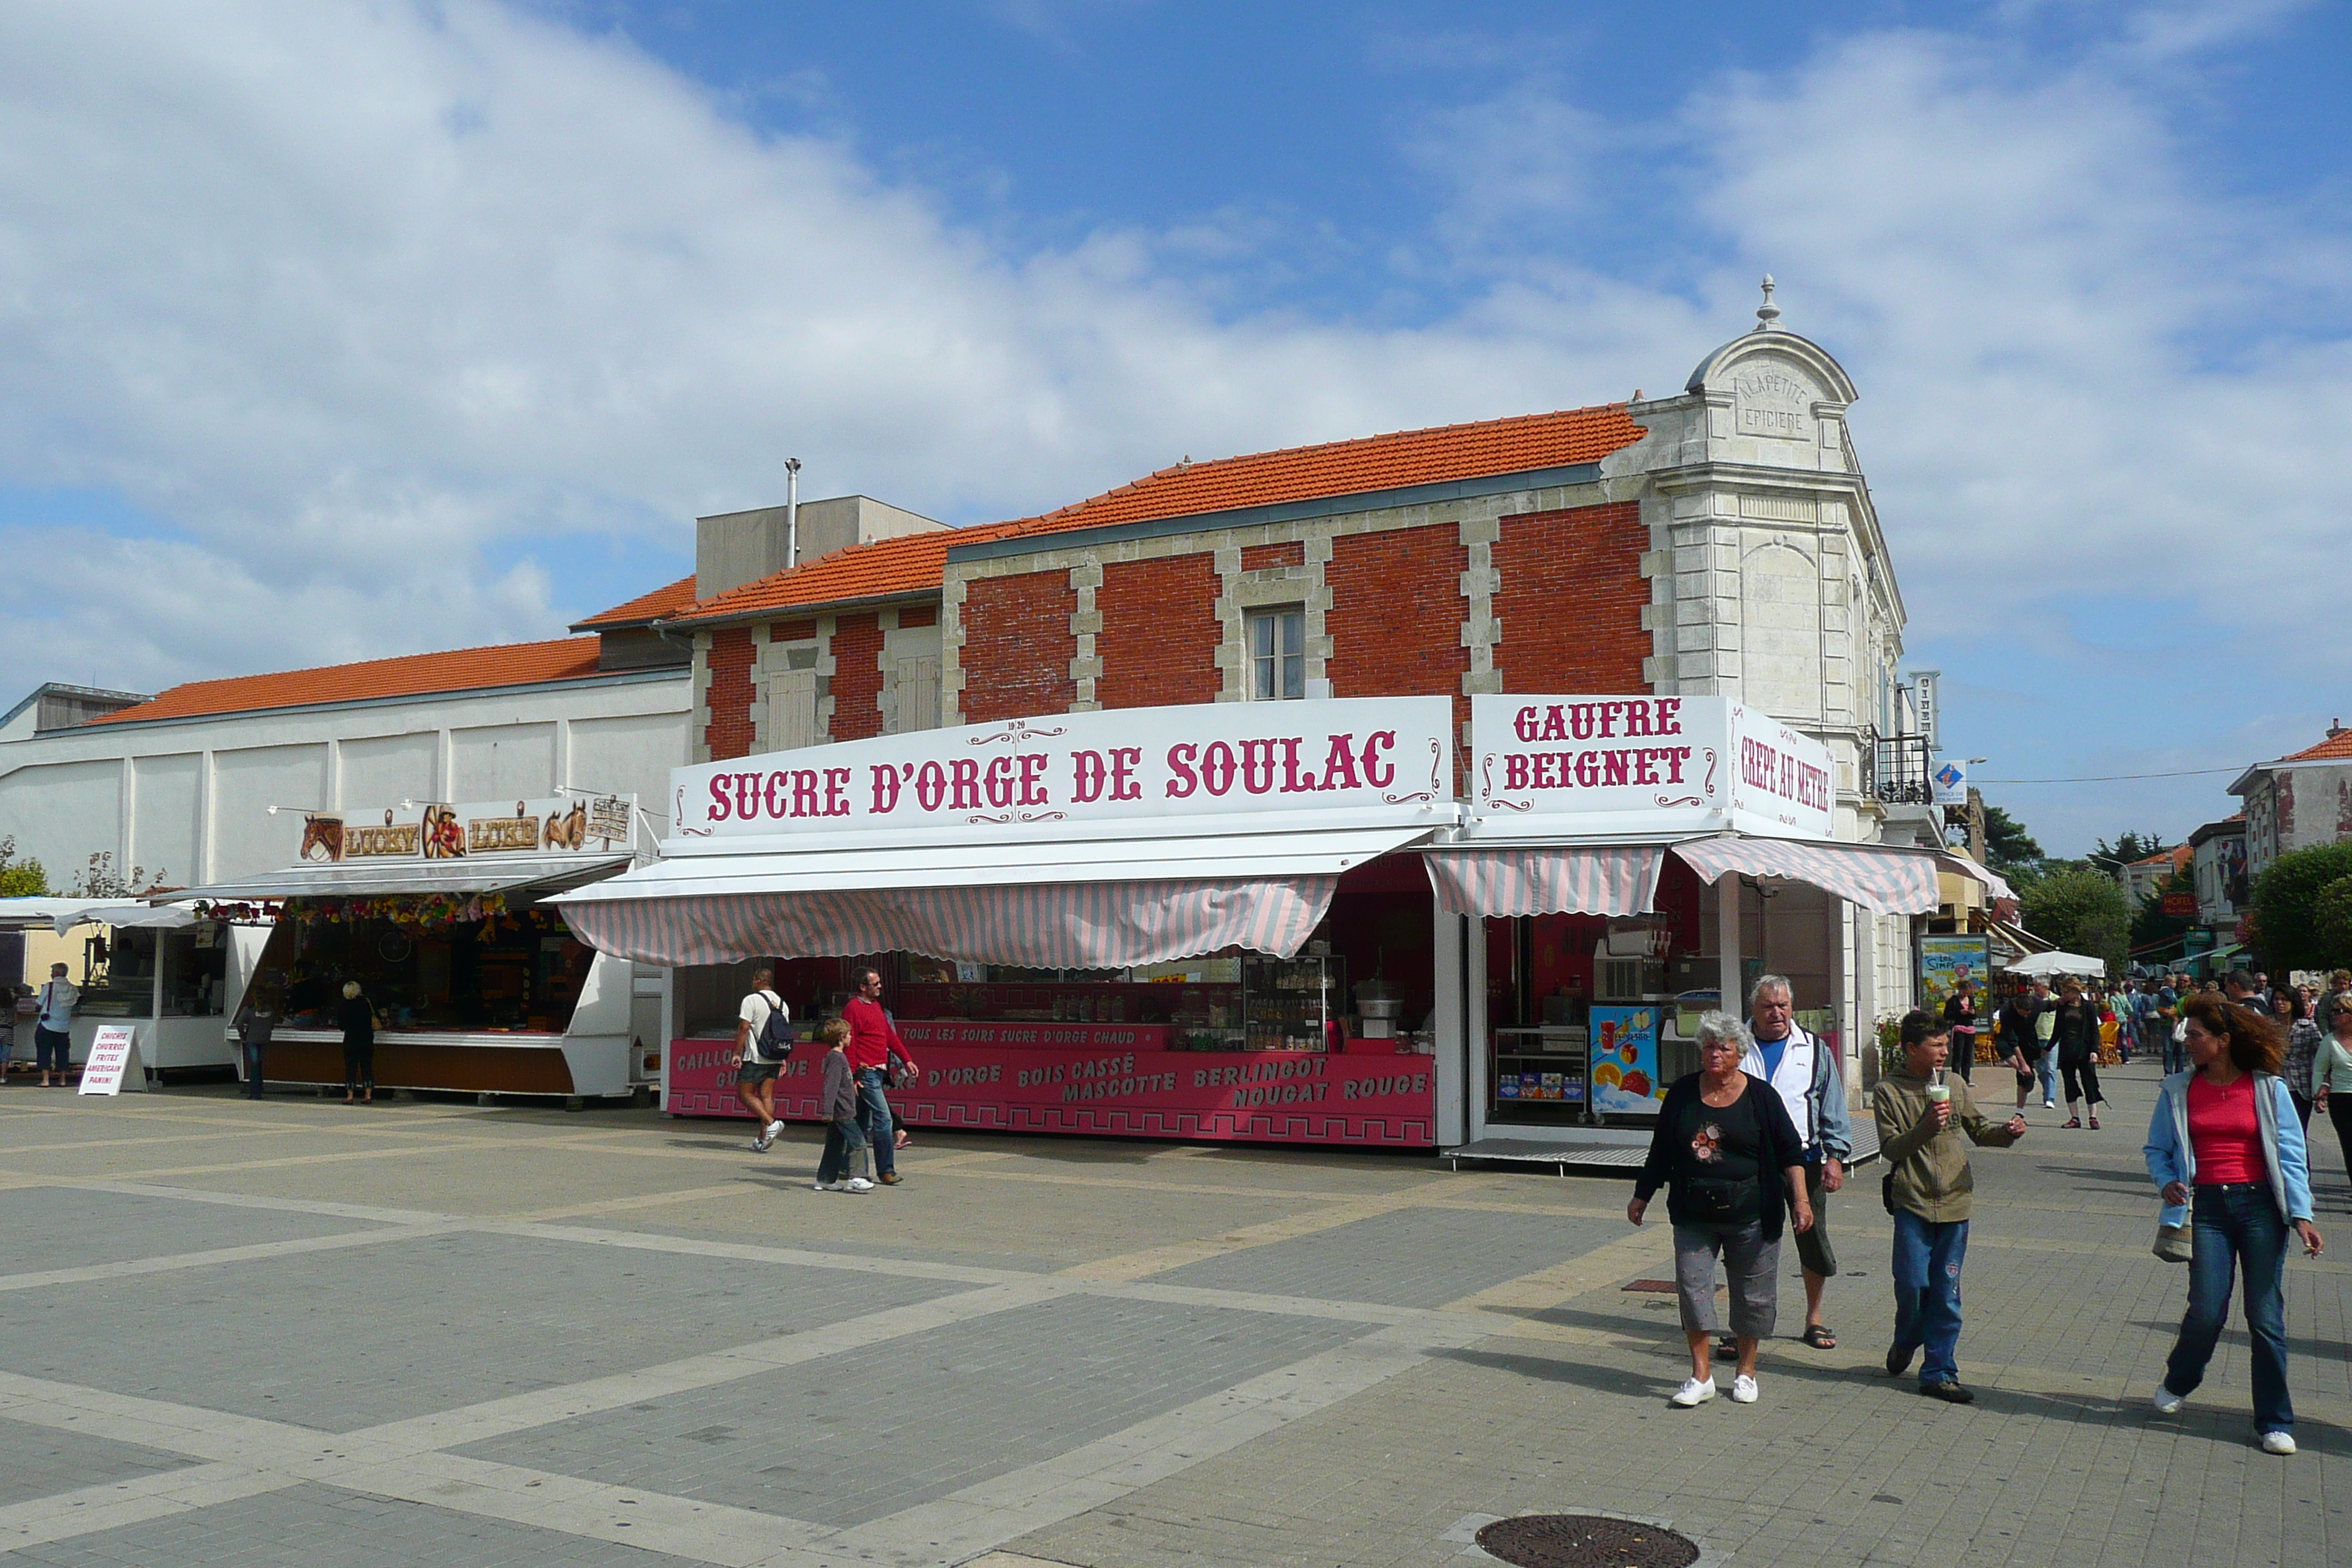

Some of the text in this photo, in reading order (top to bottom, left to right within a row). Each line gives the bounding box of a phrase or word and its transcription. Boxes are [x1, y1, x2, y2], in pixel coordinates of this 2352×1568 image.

[1745, 408, 1803, 430] EPICIERE
[1513, 697, 1683, 742] GAUFRE
[707, 730, 1398, 822] SUCRE D'ORGE DE SOULAC
[1503, 745, 1692, 791] BEIGNET
[1741, 735, 1828, 813] CREPE AU METRE
[347, 819, 535, 853] LUCKY LUKE
[2163, 897, 2193, 905] HOTEL
[101, 1032, 128, 1040] CHICHIS
[903, 1027, 1136, 1044] TOUS LES SOIRS SUCRE D'ORGE CHAUD
[95, 1054, 119, 1062] FRITES
[1017, 1051, 1136, 1088] BOIS CASSÉ
[88, 1076, 113, 1084] PANINI
[928, 1064, 1003, 1087] D'ORGE
[1194, 1057, 1328, 1088] BERLINGOT
[1062, 1071, 1177, 1103] MASCOTTE
[1232, 1082, 1329, 1108] NOUGAT
[1343, 1073, 1429, 1100] ROUGE
